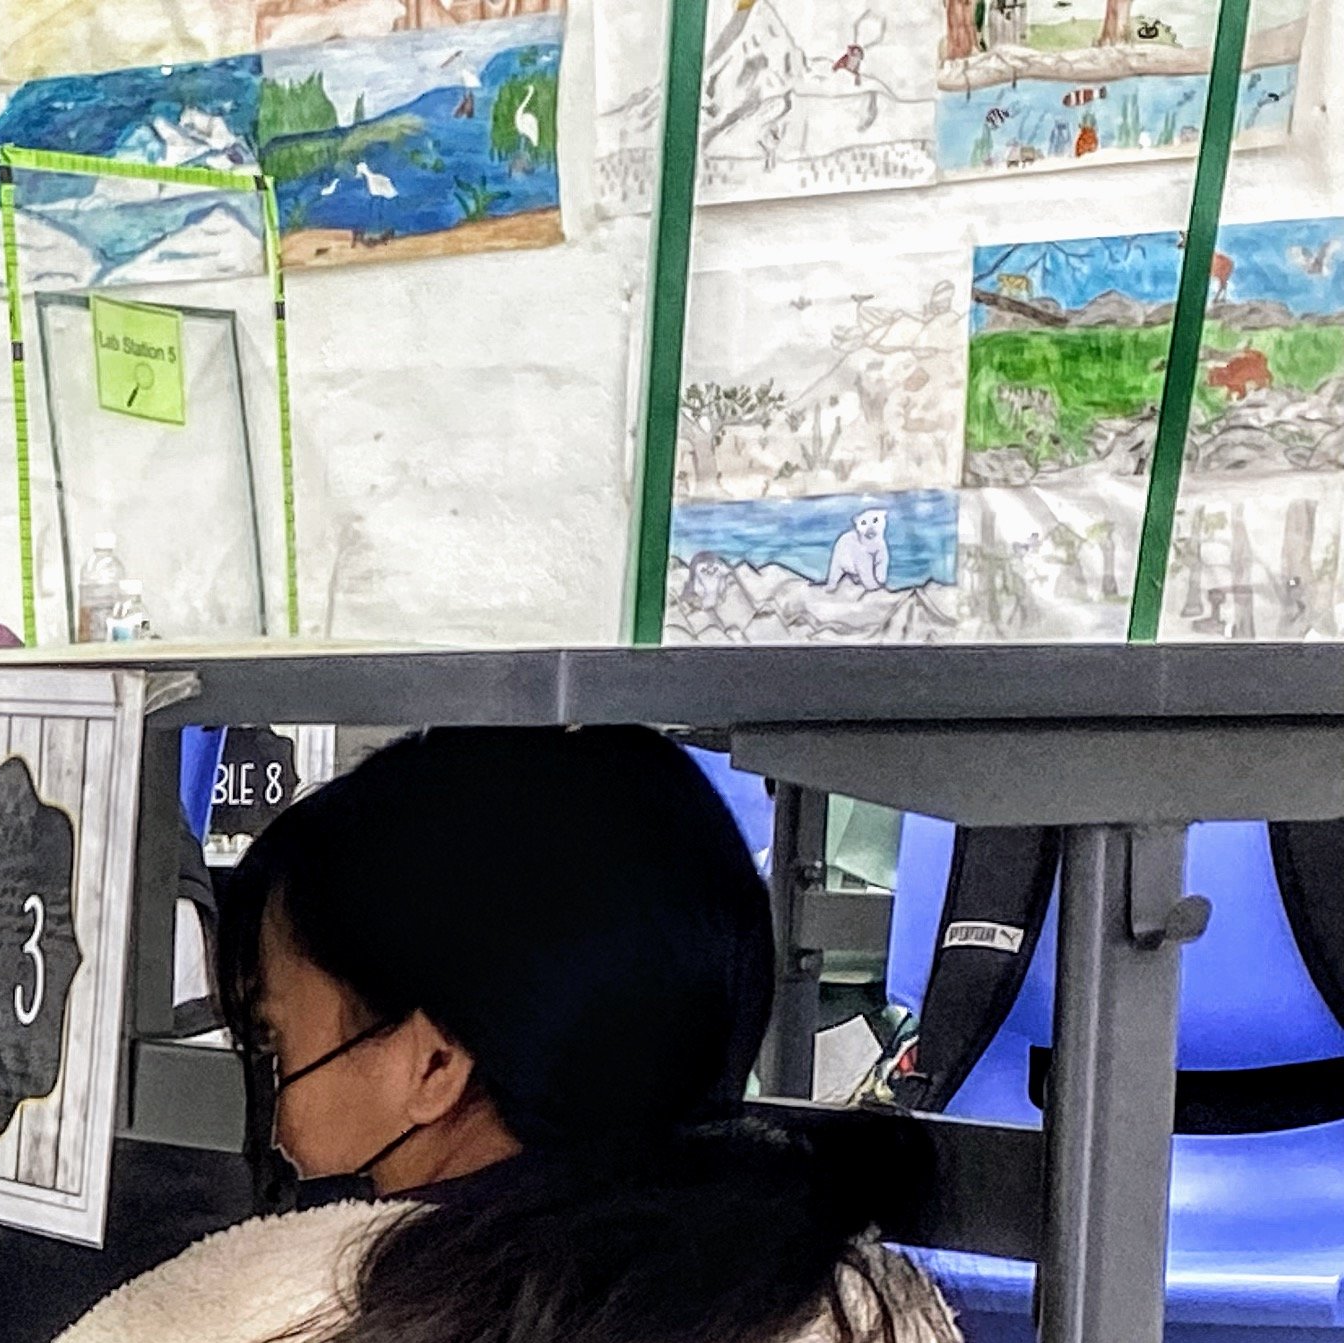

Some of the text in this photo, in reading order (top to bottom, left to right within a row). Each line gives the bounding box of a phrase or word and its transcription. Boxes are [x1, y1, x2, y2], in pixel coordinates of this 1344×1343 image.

[97, 330, 177, 364] Lab Station 5
[212, 762, 283, 805] BLE 8
[14, 895, 43, 1025] 3
